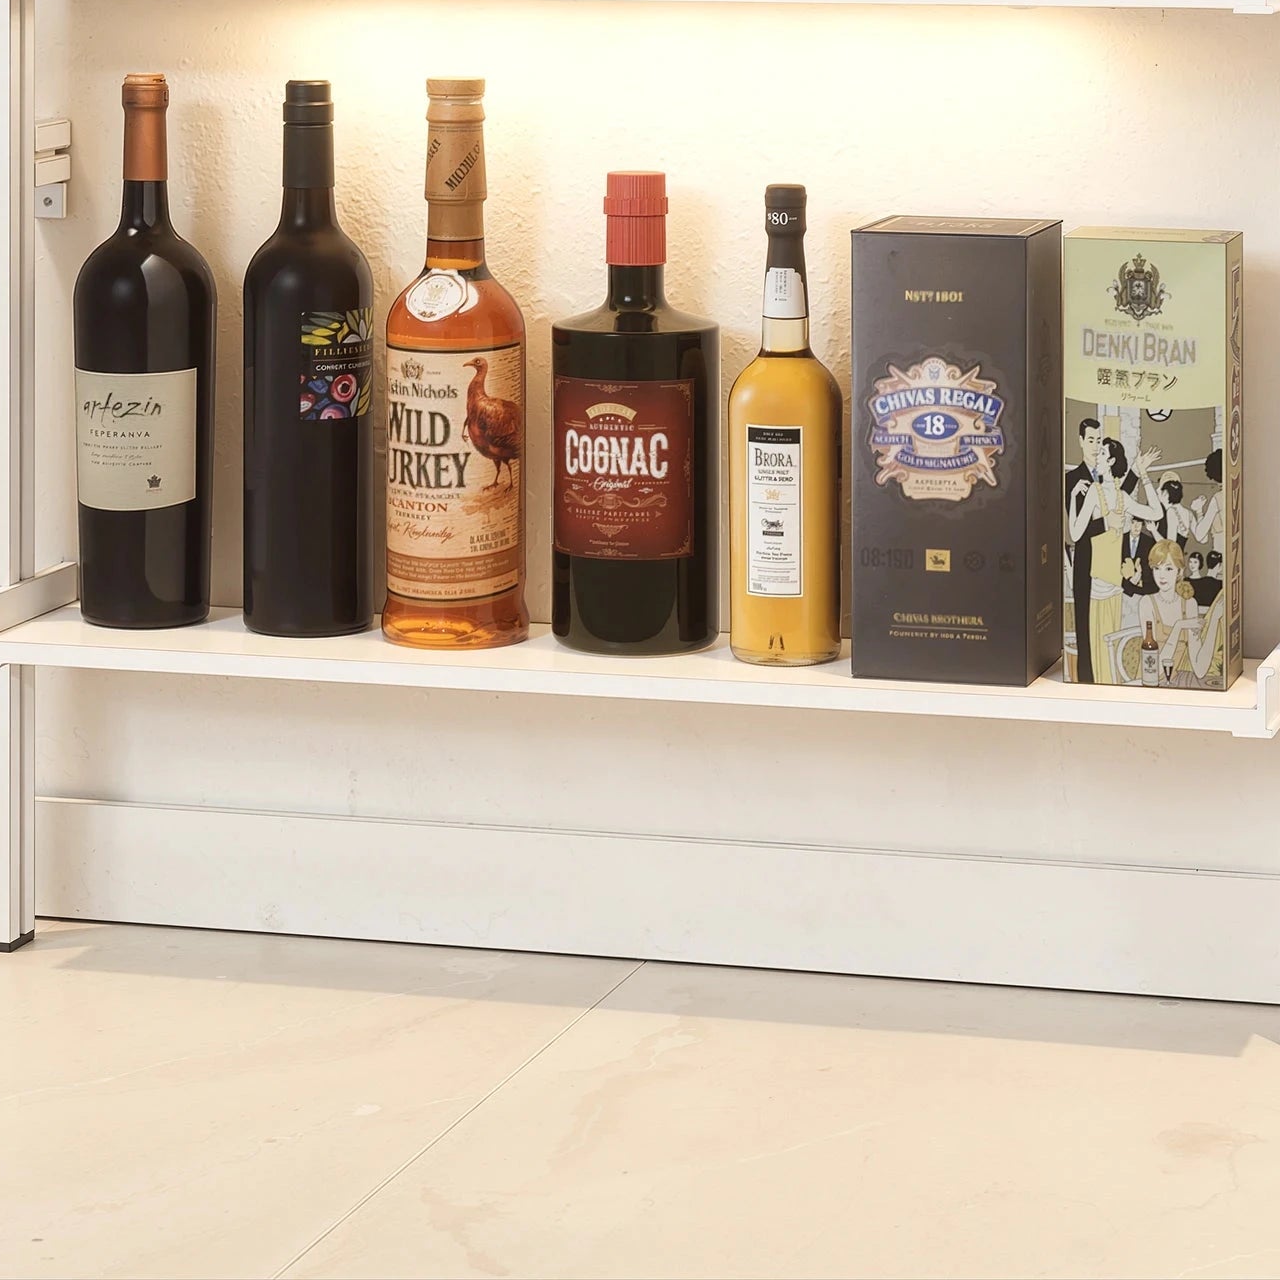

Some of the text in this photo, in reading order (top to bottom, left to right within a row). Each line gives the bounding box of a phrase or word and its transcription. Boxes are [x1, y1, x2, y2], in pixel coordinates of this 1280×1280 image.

[1082, 328, 1197, 367] DENKI BRAN
[875, 388, 997, 416] CHIVAS REGAL
[389, 401, 451, 447] WILD
[923, 415, 945, 435] 18
[565, 428, 669, 479] COGNAC
